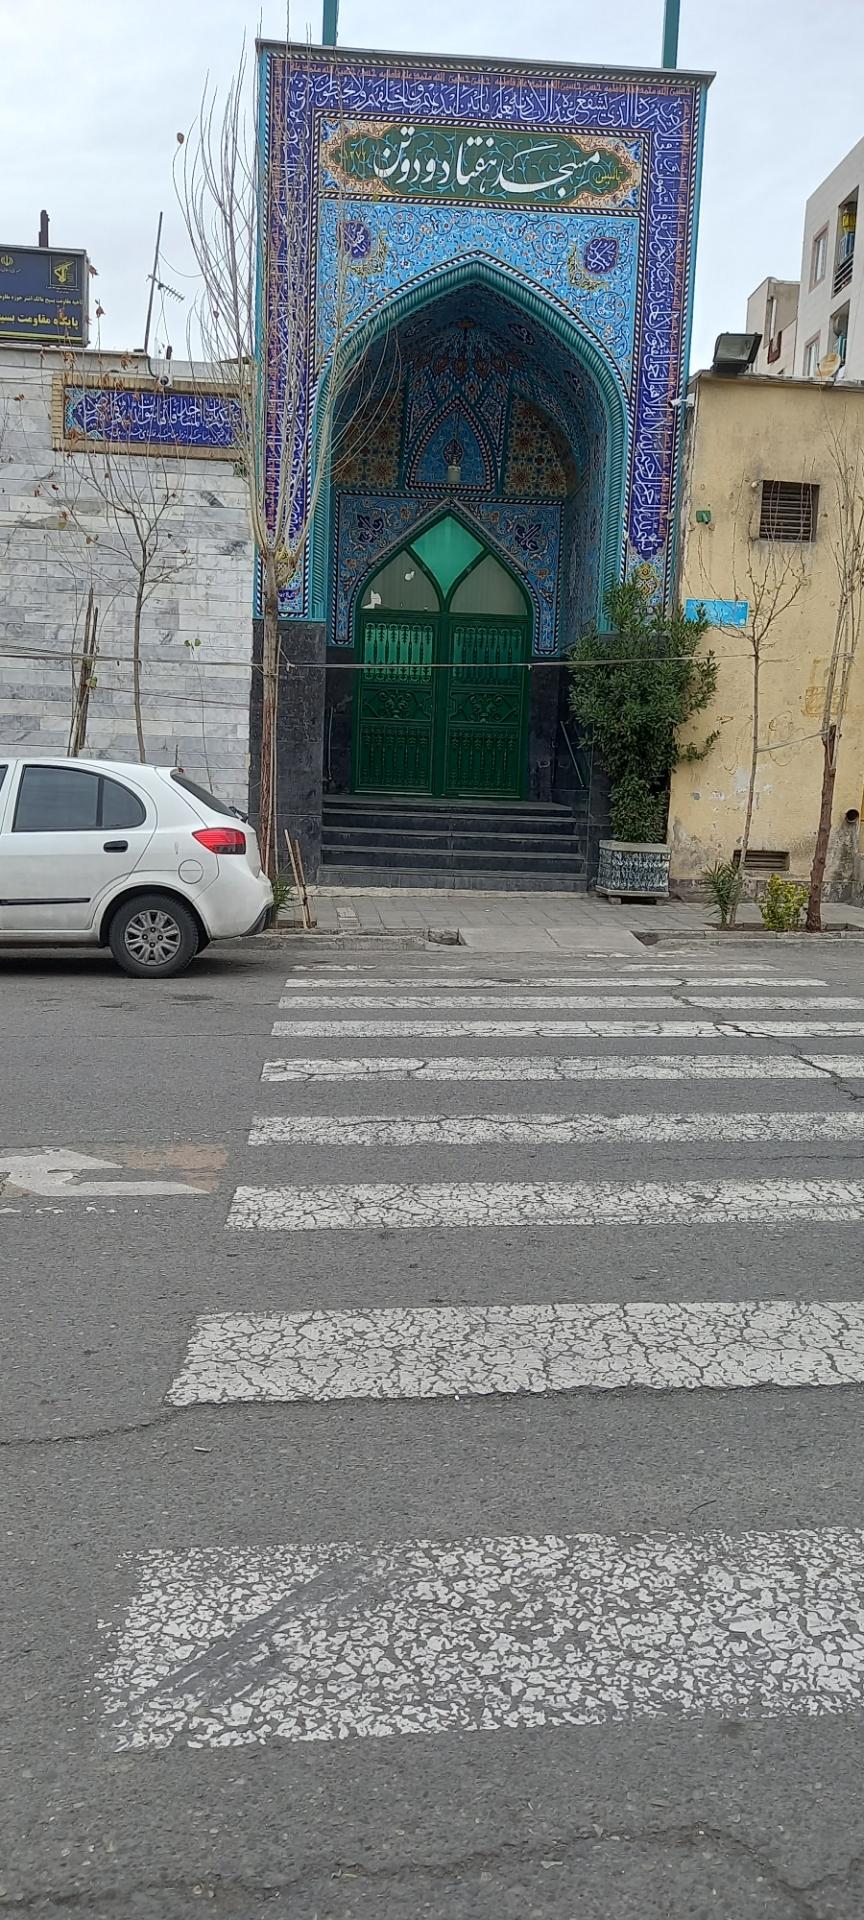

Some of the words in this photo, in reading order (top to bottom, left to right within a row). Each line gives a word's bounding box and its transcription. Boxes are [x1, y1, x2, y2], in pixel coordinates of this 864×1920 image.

[373, 126, 415, 178] تن
[421, 158, 436, 184] و
[438, 135, 497, 193] هفتاد
[490, 144, 600, 198] مسجد
[0, 314, 15, 325] بسی
[17, 313, 51, 327] مقاومت
